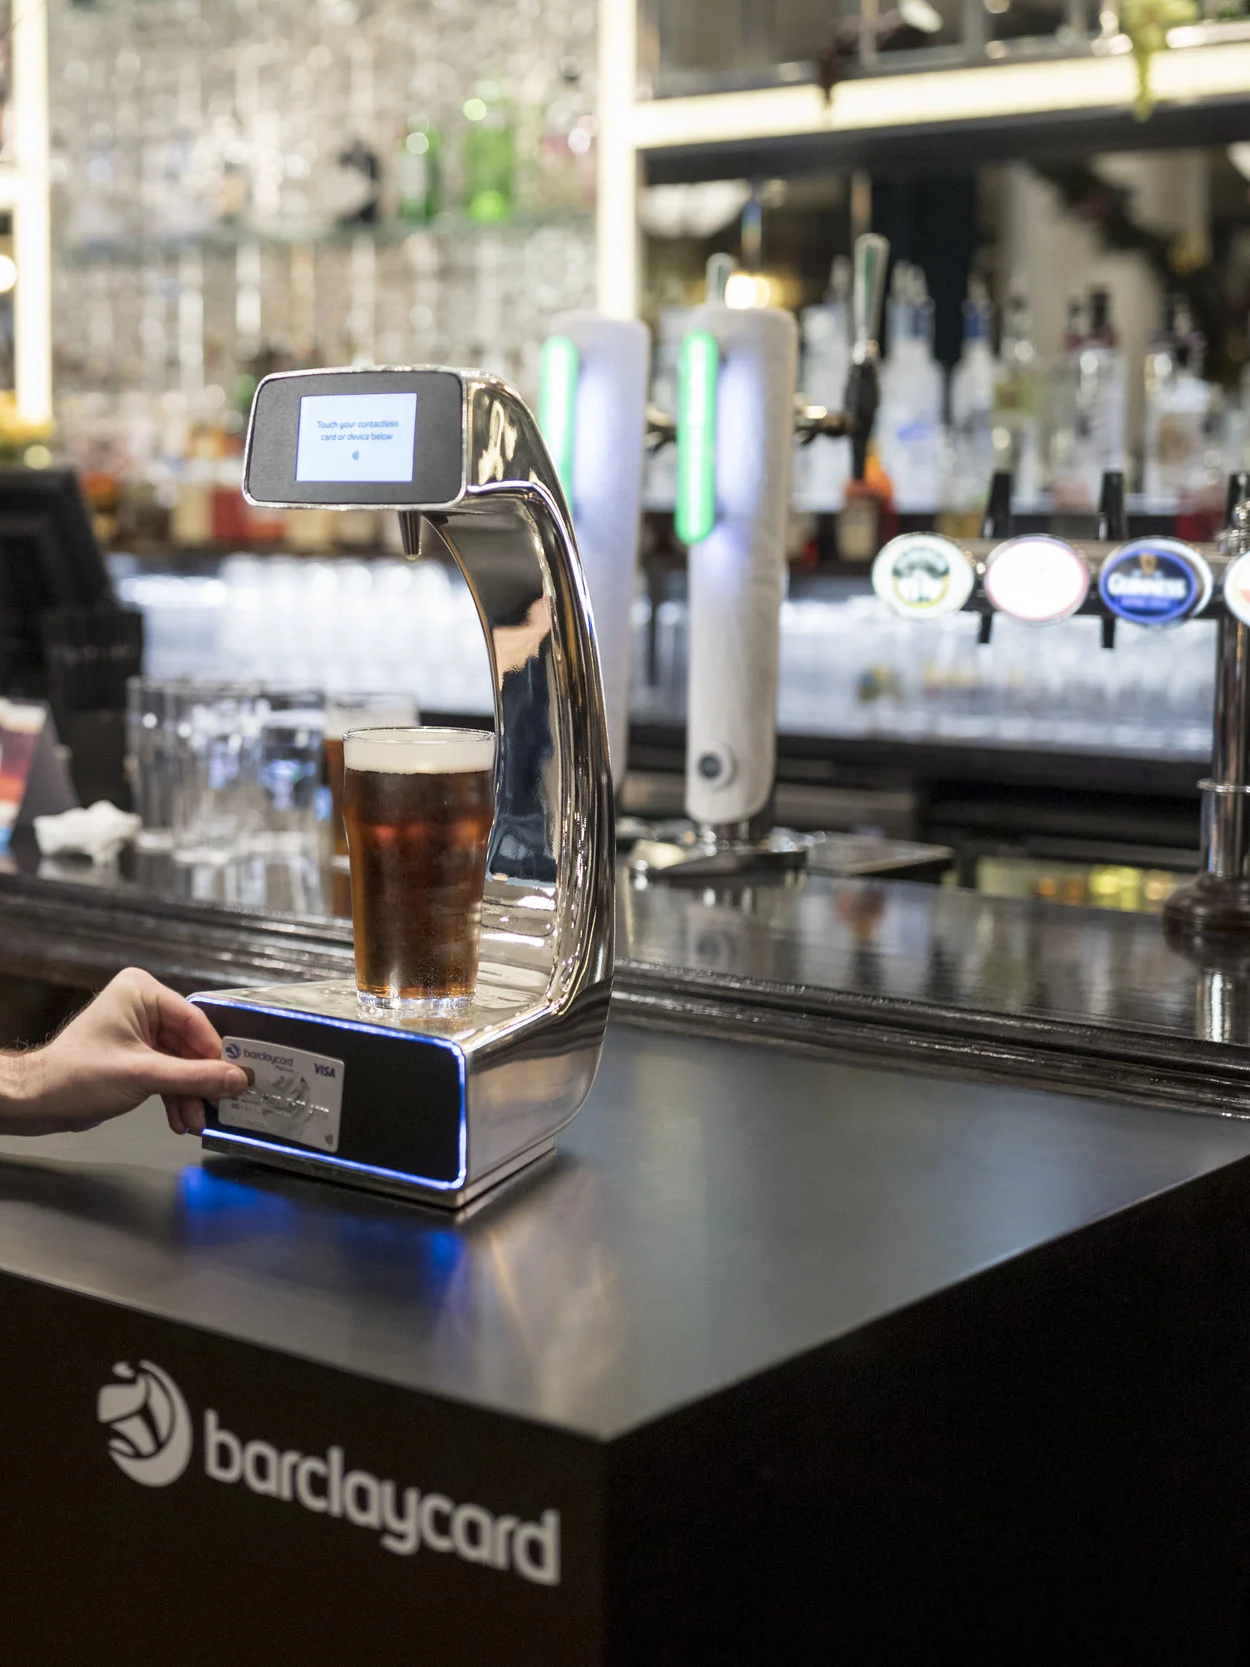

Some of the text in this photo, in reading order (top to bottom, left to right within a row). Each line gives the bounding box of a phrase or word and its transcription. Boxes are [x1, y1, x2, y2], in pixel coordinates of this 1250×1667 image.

[317, 420, 338, 428] Touch
[339, 422, 356, 430] your
[371, 432, 393, 440] below
[244, 1048, 294, 1067] barclaycard
[314, 1063, 336, 1078] VISA
[203, 1408, 561, 1586] barclaycard
